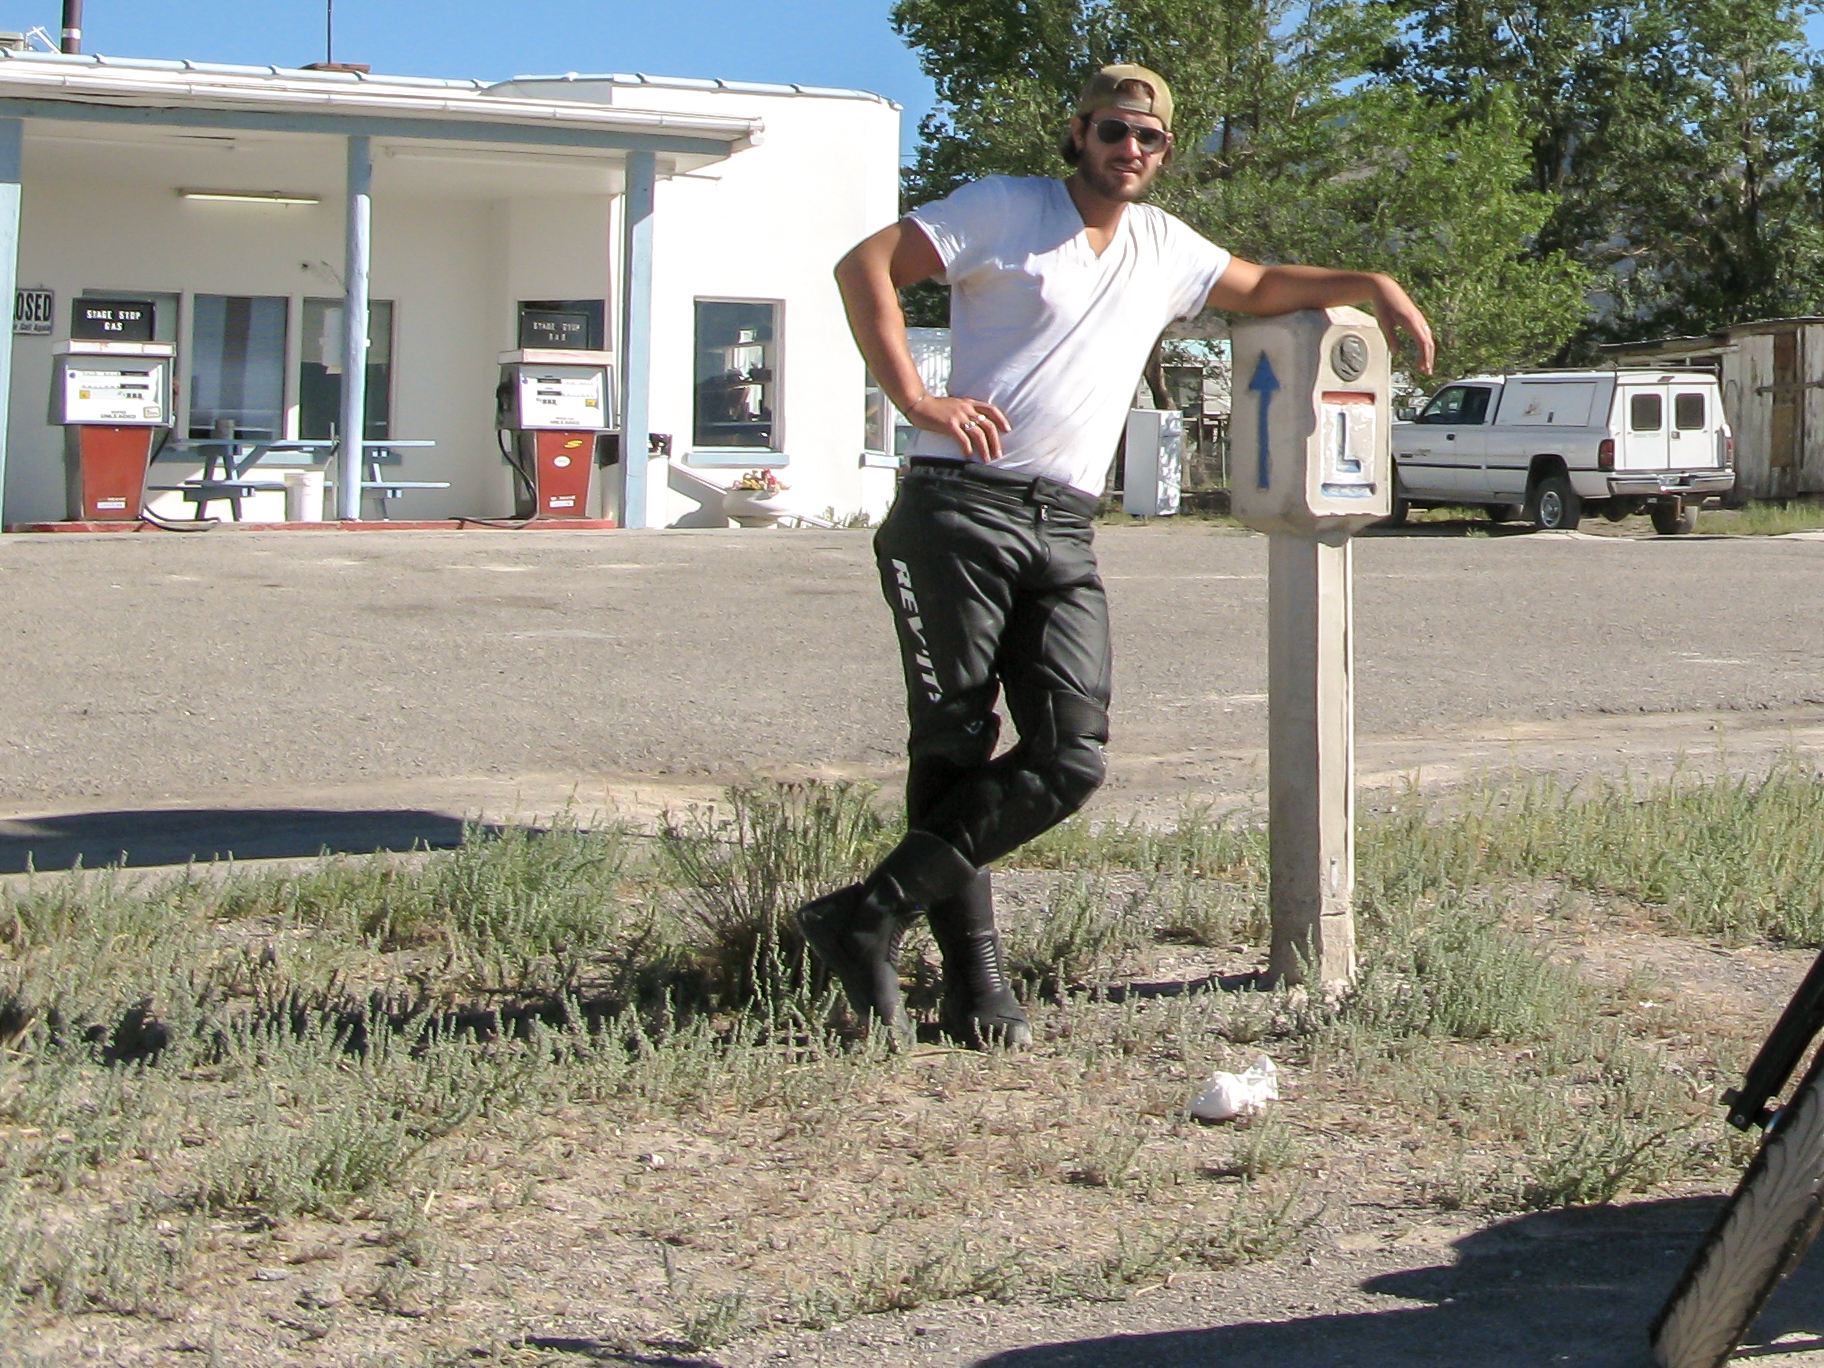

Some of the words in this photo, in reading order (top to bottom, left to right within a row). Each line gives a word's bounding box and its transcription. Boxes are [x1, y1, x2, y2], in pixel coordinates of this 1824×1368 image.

[15, 292, 52, 321] OSED
[86, 309, 113, 320] STAGE
[118, 310, 142, 320] STOP
[104, 321, 123, 331] GAS
[1335, 411, 1362, 473] L
